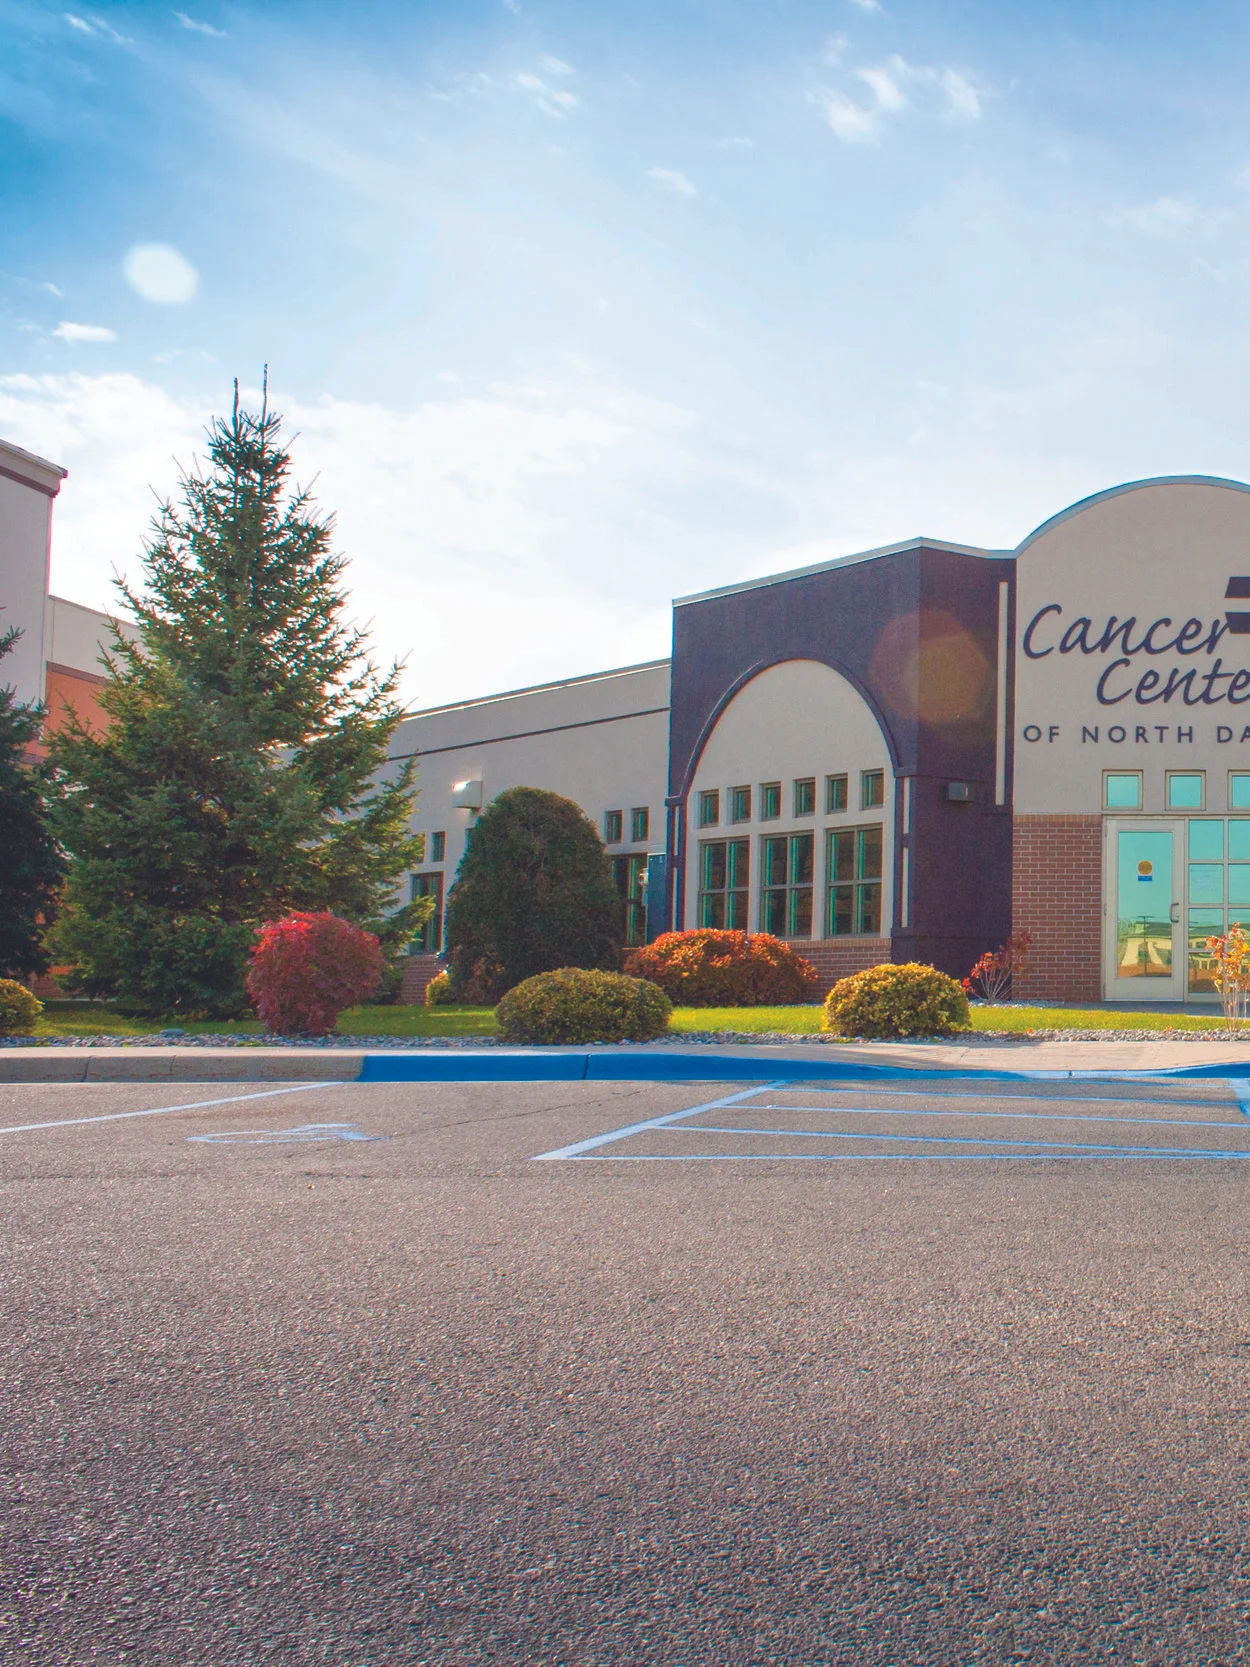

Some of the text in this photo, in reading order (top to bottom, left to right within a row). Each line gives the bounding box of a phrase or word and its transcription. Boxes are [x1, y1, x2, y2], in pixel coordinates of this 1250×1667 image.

[1023, 604, 1232, 659] Cancer
[1023, 724, 1060, 743] OF
[1082, 725, 1194, 743] NORTH
